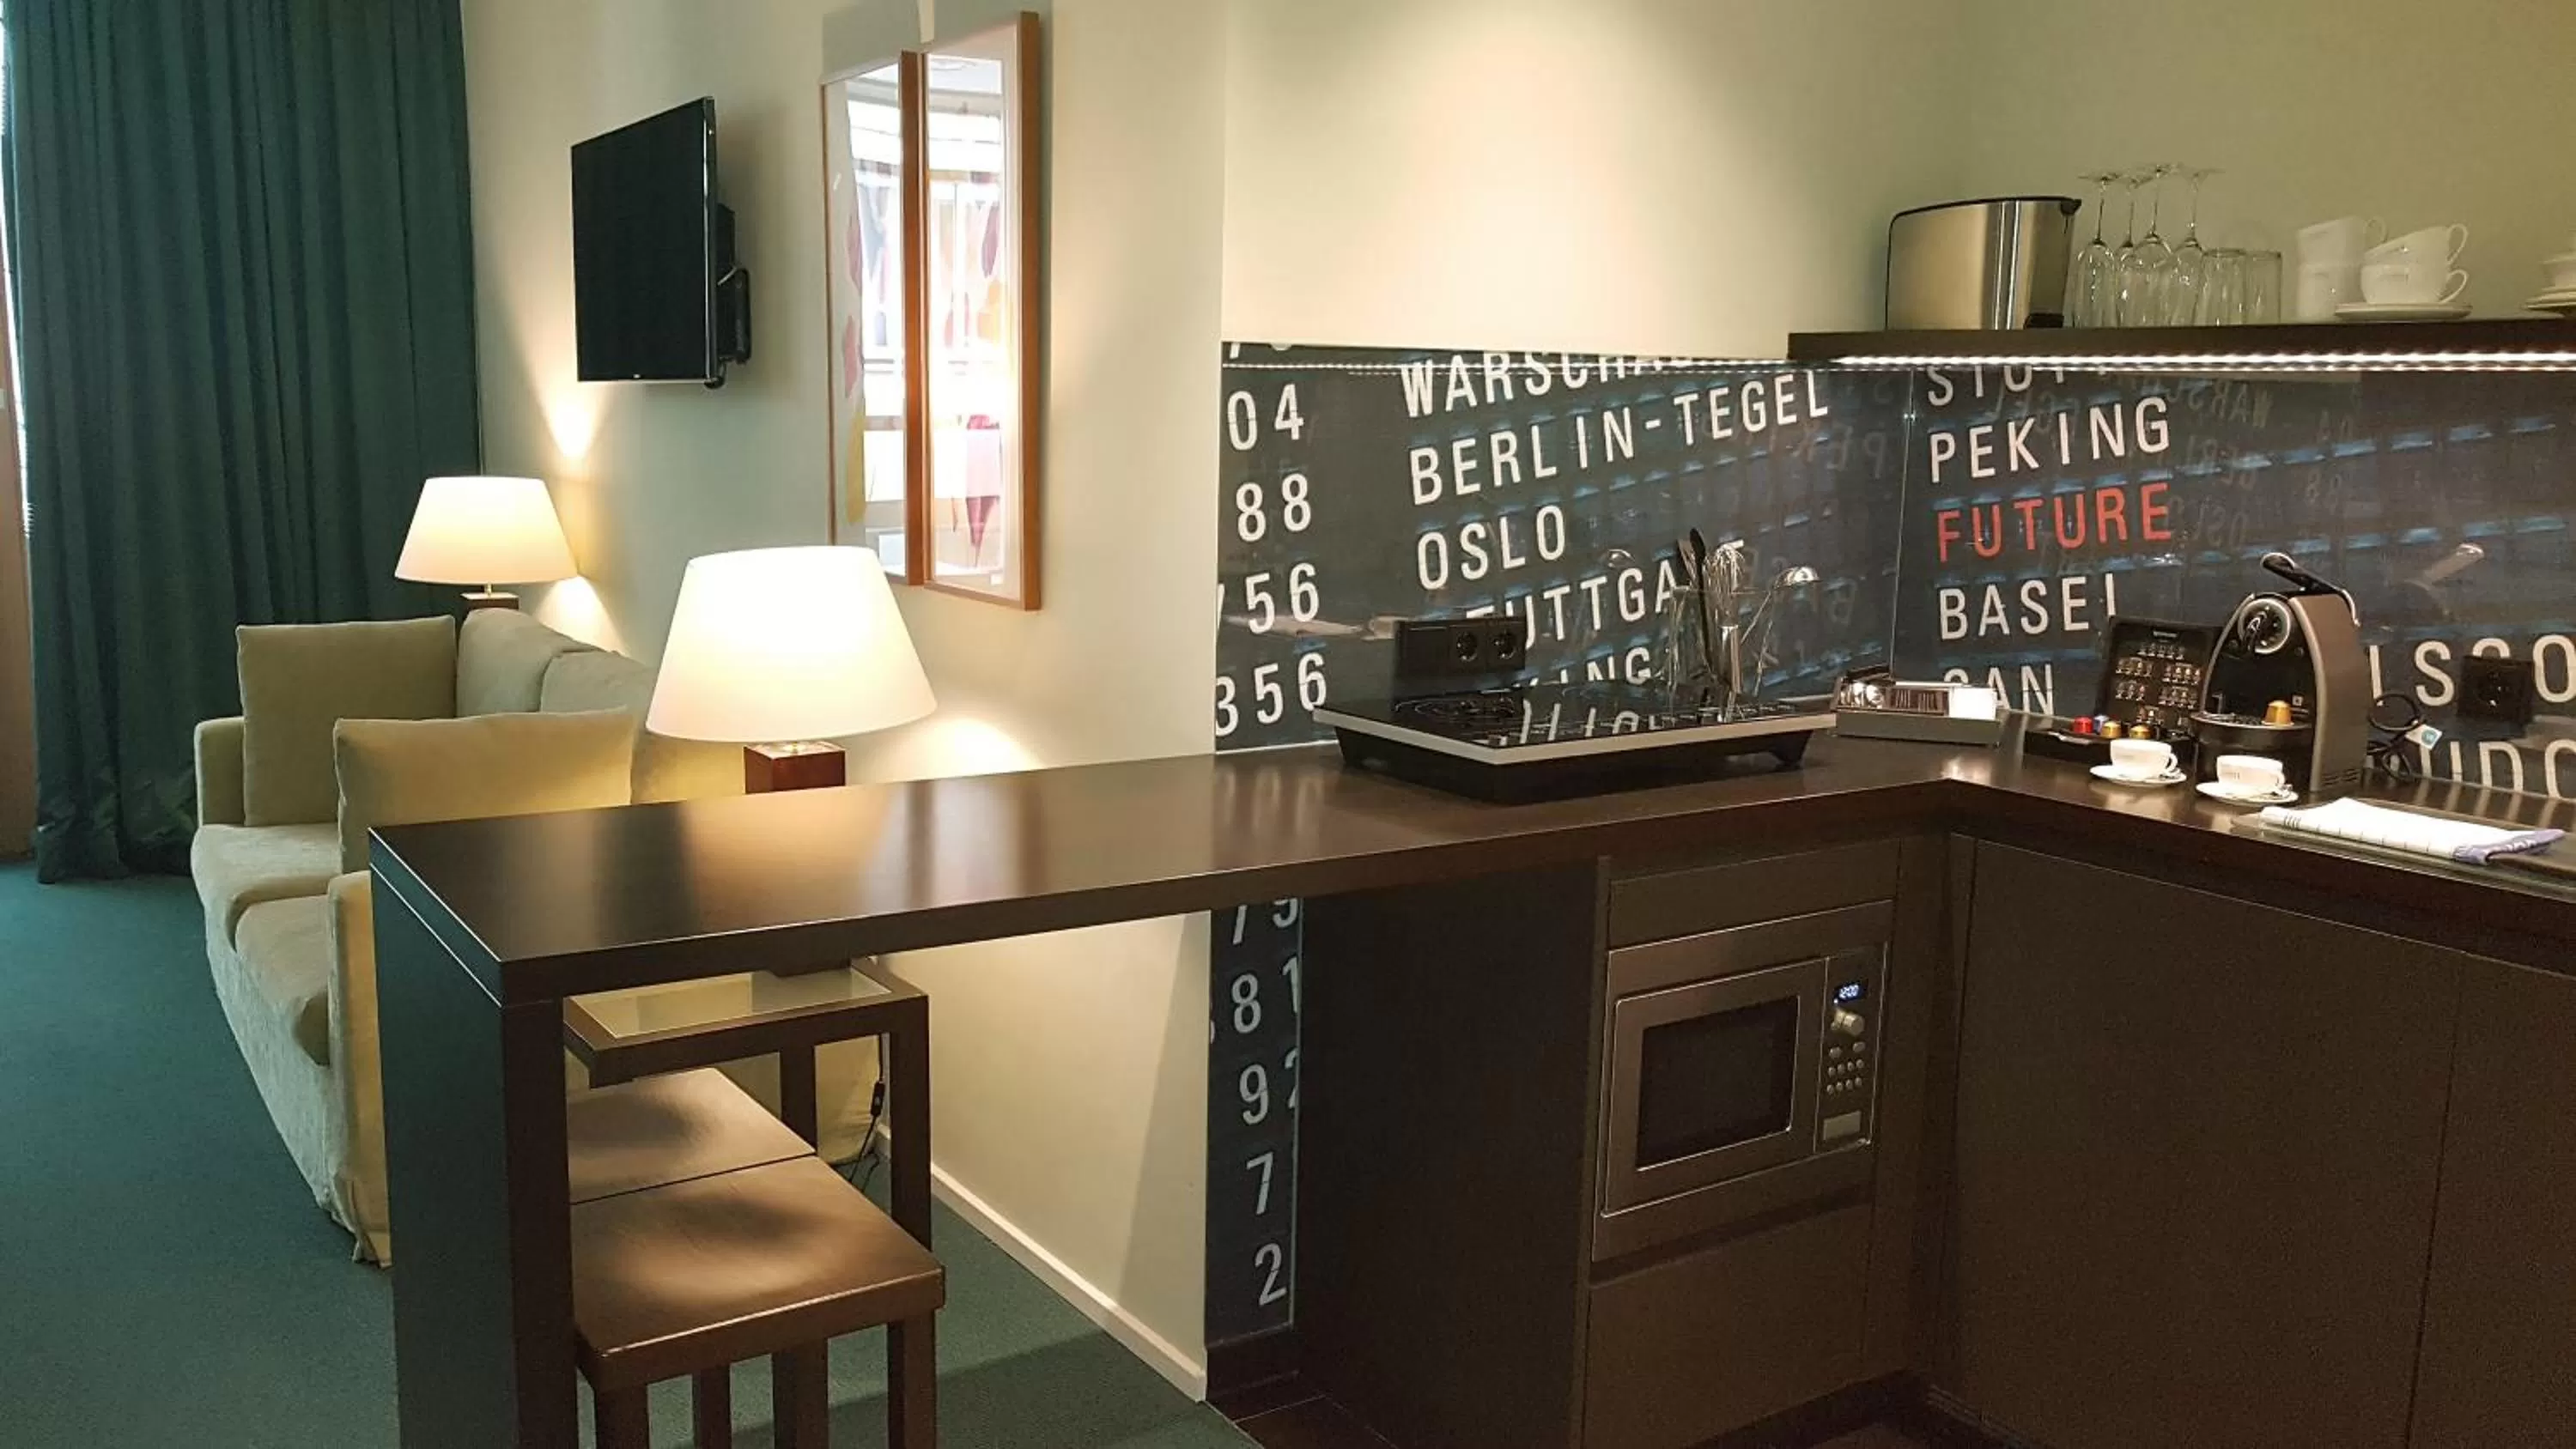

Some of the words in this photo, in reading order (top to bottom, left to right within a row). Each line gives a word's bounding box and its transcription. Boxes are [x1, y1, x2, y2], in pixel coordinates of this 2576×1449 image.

[1409, 369, 1829, 506] BERLIN-TEGEL
[1930, 396, 2170, 483] PEKING
[1236, 473, 1312, 543] 88
[1417, 505, 1566, 591] OSLO
[1936, 482, 2172, 563] FUTURE
[1247, 1152, 1273, 1215] 7
[1255, 1242, 1287, 1307] 2
